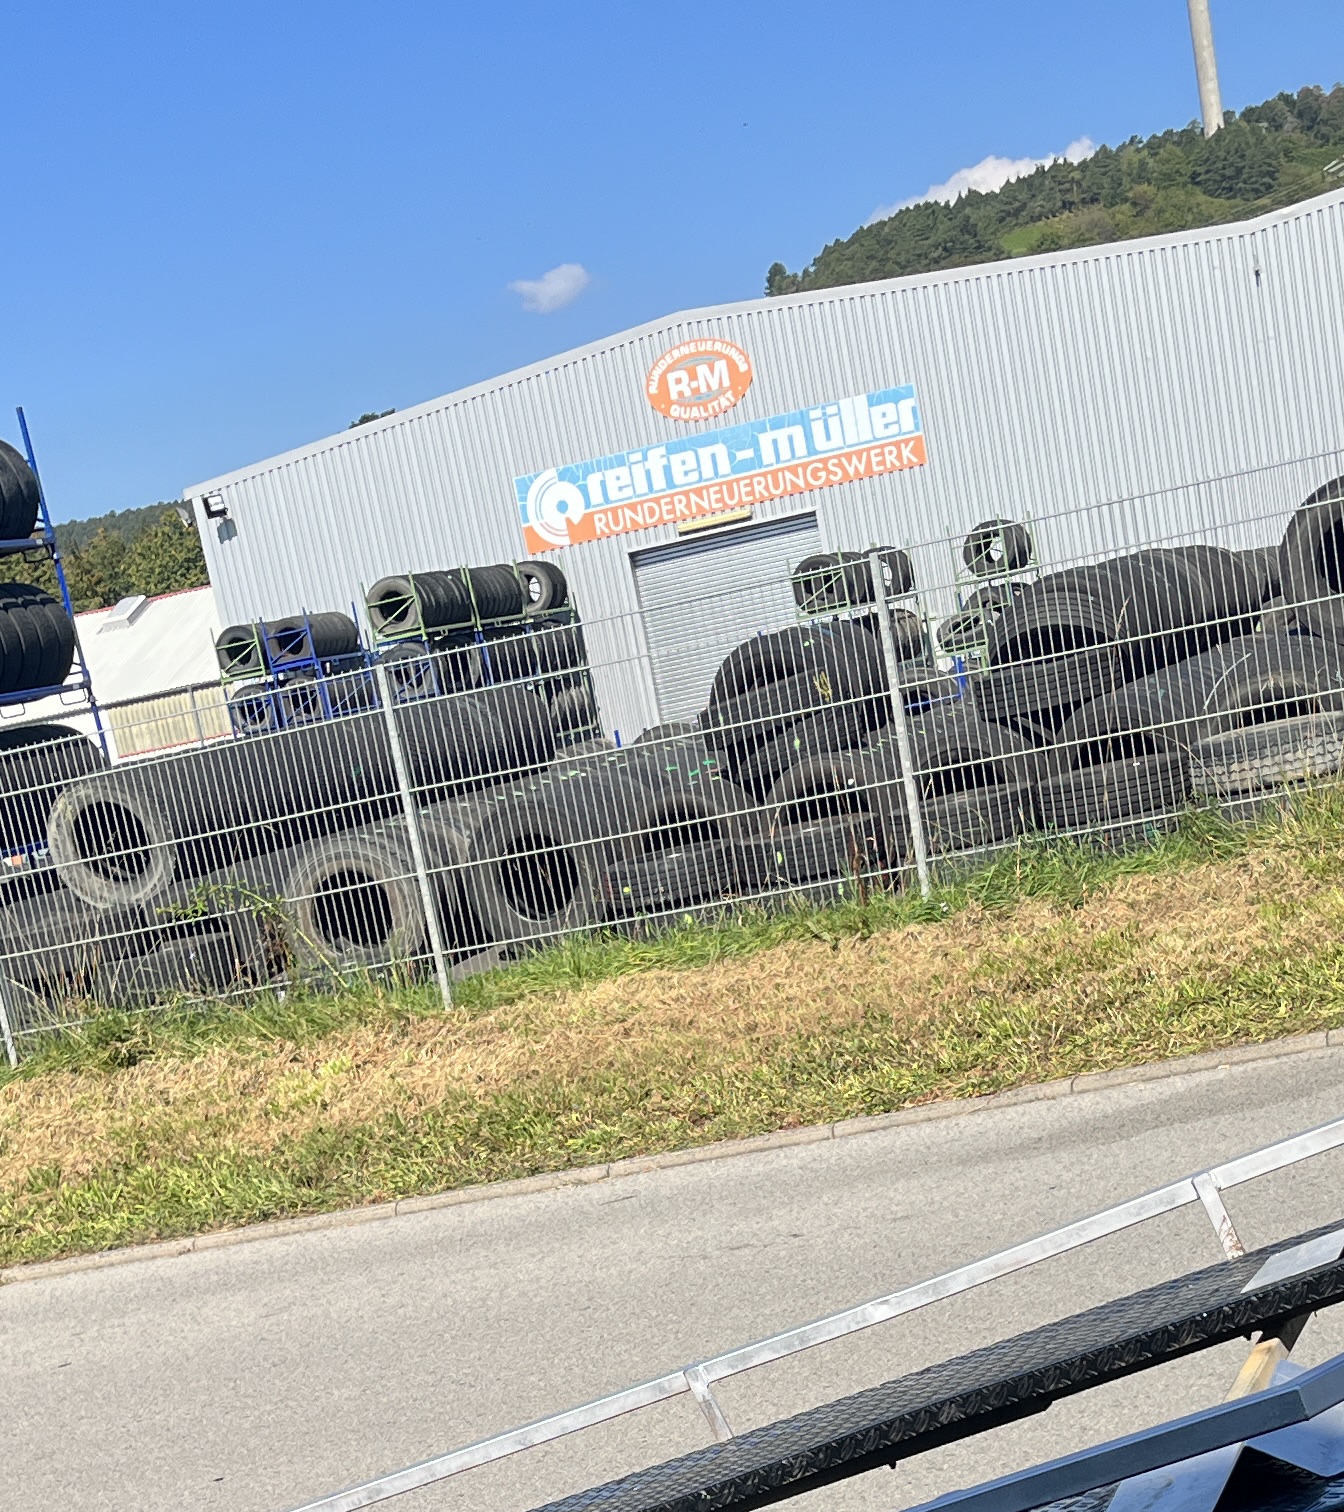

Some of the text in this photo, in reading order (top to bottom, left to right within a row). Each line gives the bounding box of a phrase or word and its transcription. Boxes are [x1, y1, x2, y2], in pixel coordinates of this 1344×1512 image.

[666, 359, 731, 401] R-M
[669, 390, 736, 419] QUALITÄT
[593, 440, 919, 536] RUNDERNEUERUNGSWERK
